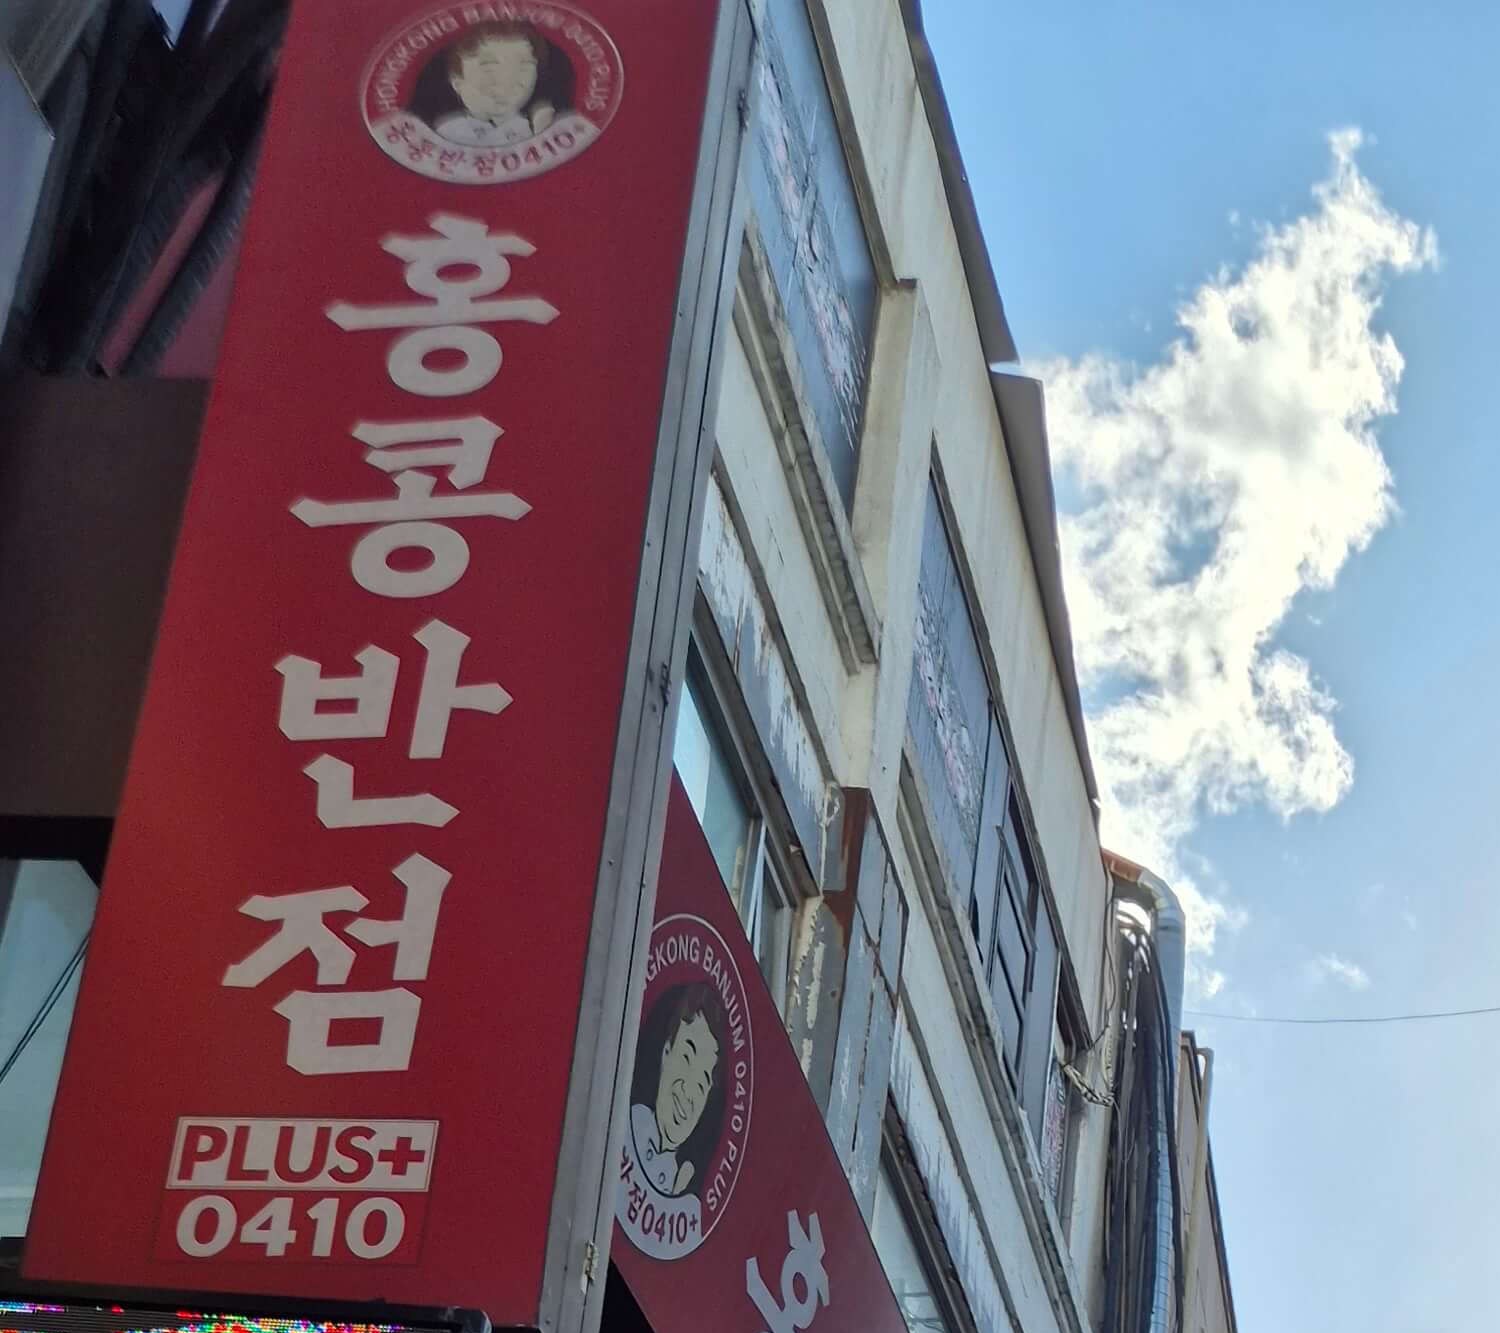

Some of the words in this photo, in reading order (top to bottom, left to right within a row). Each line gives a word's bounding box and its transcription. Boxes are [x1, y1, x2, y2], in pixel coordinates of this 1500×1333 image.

[222, 213, 560, 1076] 홍콩반점
[701, 947, 746, 1053] BANJUM
[730, 1060, 747, 1134] 0410
[705, 1141, 737, 1213] PLUS
[176, 1195, 405, 1258] 0410
